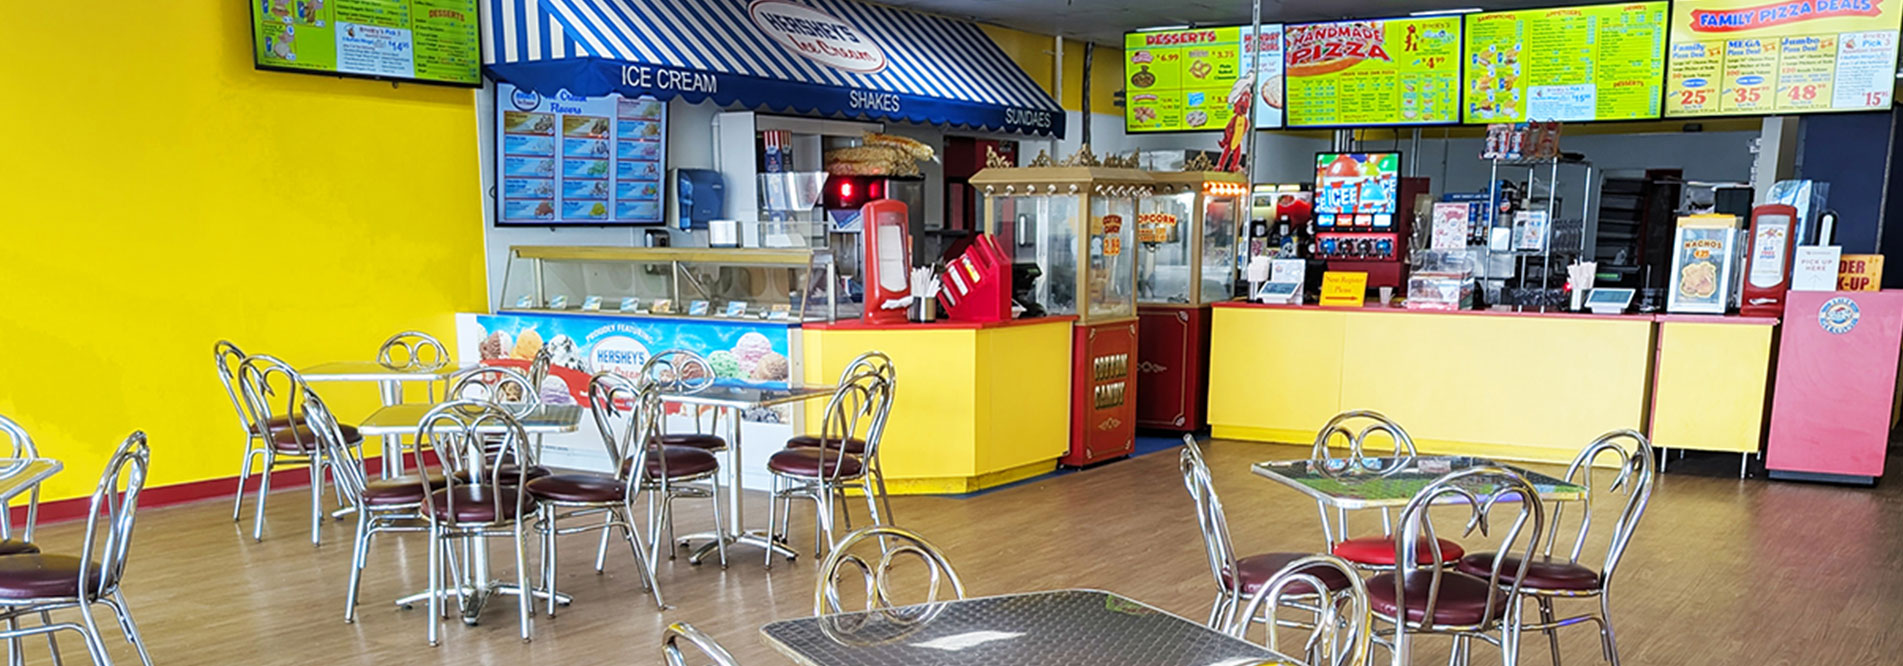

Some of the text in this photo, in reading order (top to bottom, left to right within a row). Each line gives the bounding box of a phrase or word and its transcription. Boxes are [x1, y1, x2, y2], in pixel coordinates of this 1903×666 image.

[1699, 0, 1872, 26] FAMILY PIZZA DEALS
[760, 11, 861, 43] HERSHEY'S
[1293, 25, 1383, 45] HANDMADE
[787, 34, 877, 62] Ice Cream
[1146, 31, 1217, 46] DESSERTS
[1728, 40, 1761, 49] MEGA
[1781, 37, 1820, 46] Jumbo
[1290, 42, 1393, 66] PIZZA
[621, 65, 718, 93] ICE CREAM
[849, 90, 901, 112] SHAKES
[1004, 106, 1051, 128] SUNDAES
[1328, 187, 1357, 207] ICEE
[1138, 213, 1177, 226] OPCORN
[1684, 239, 1722, 250] NACHOS
[1839, 259, 1866, 274] DER
[1836, 276, 1870, 291] K-UP
[597, 349, 645, 366] HERSHEY'S
[1093, 354, 1128, 381] COTTON
[1094, 382, 1126, 410] CANDY
